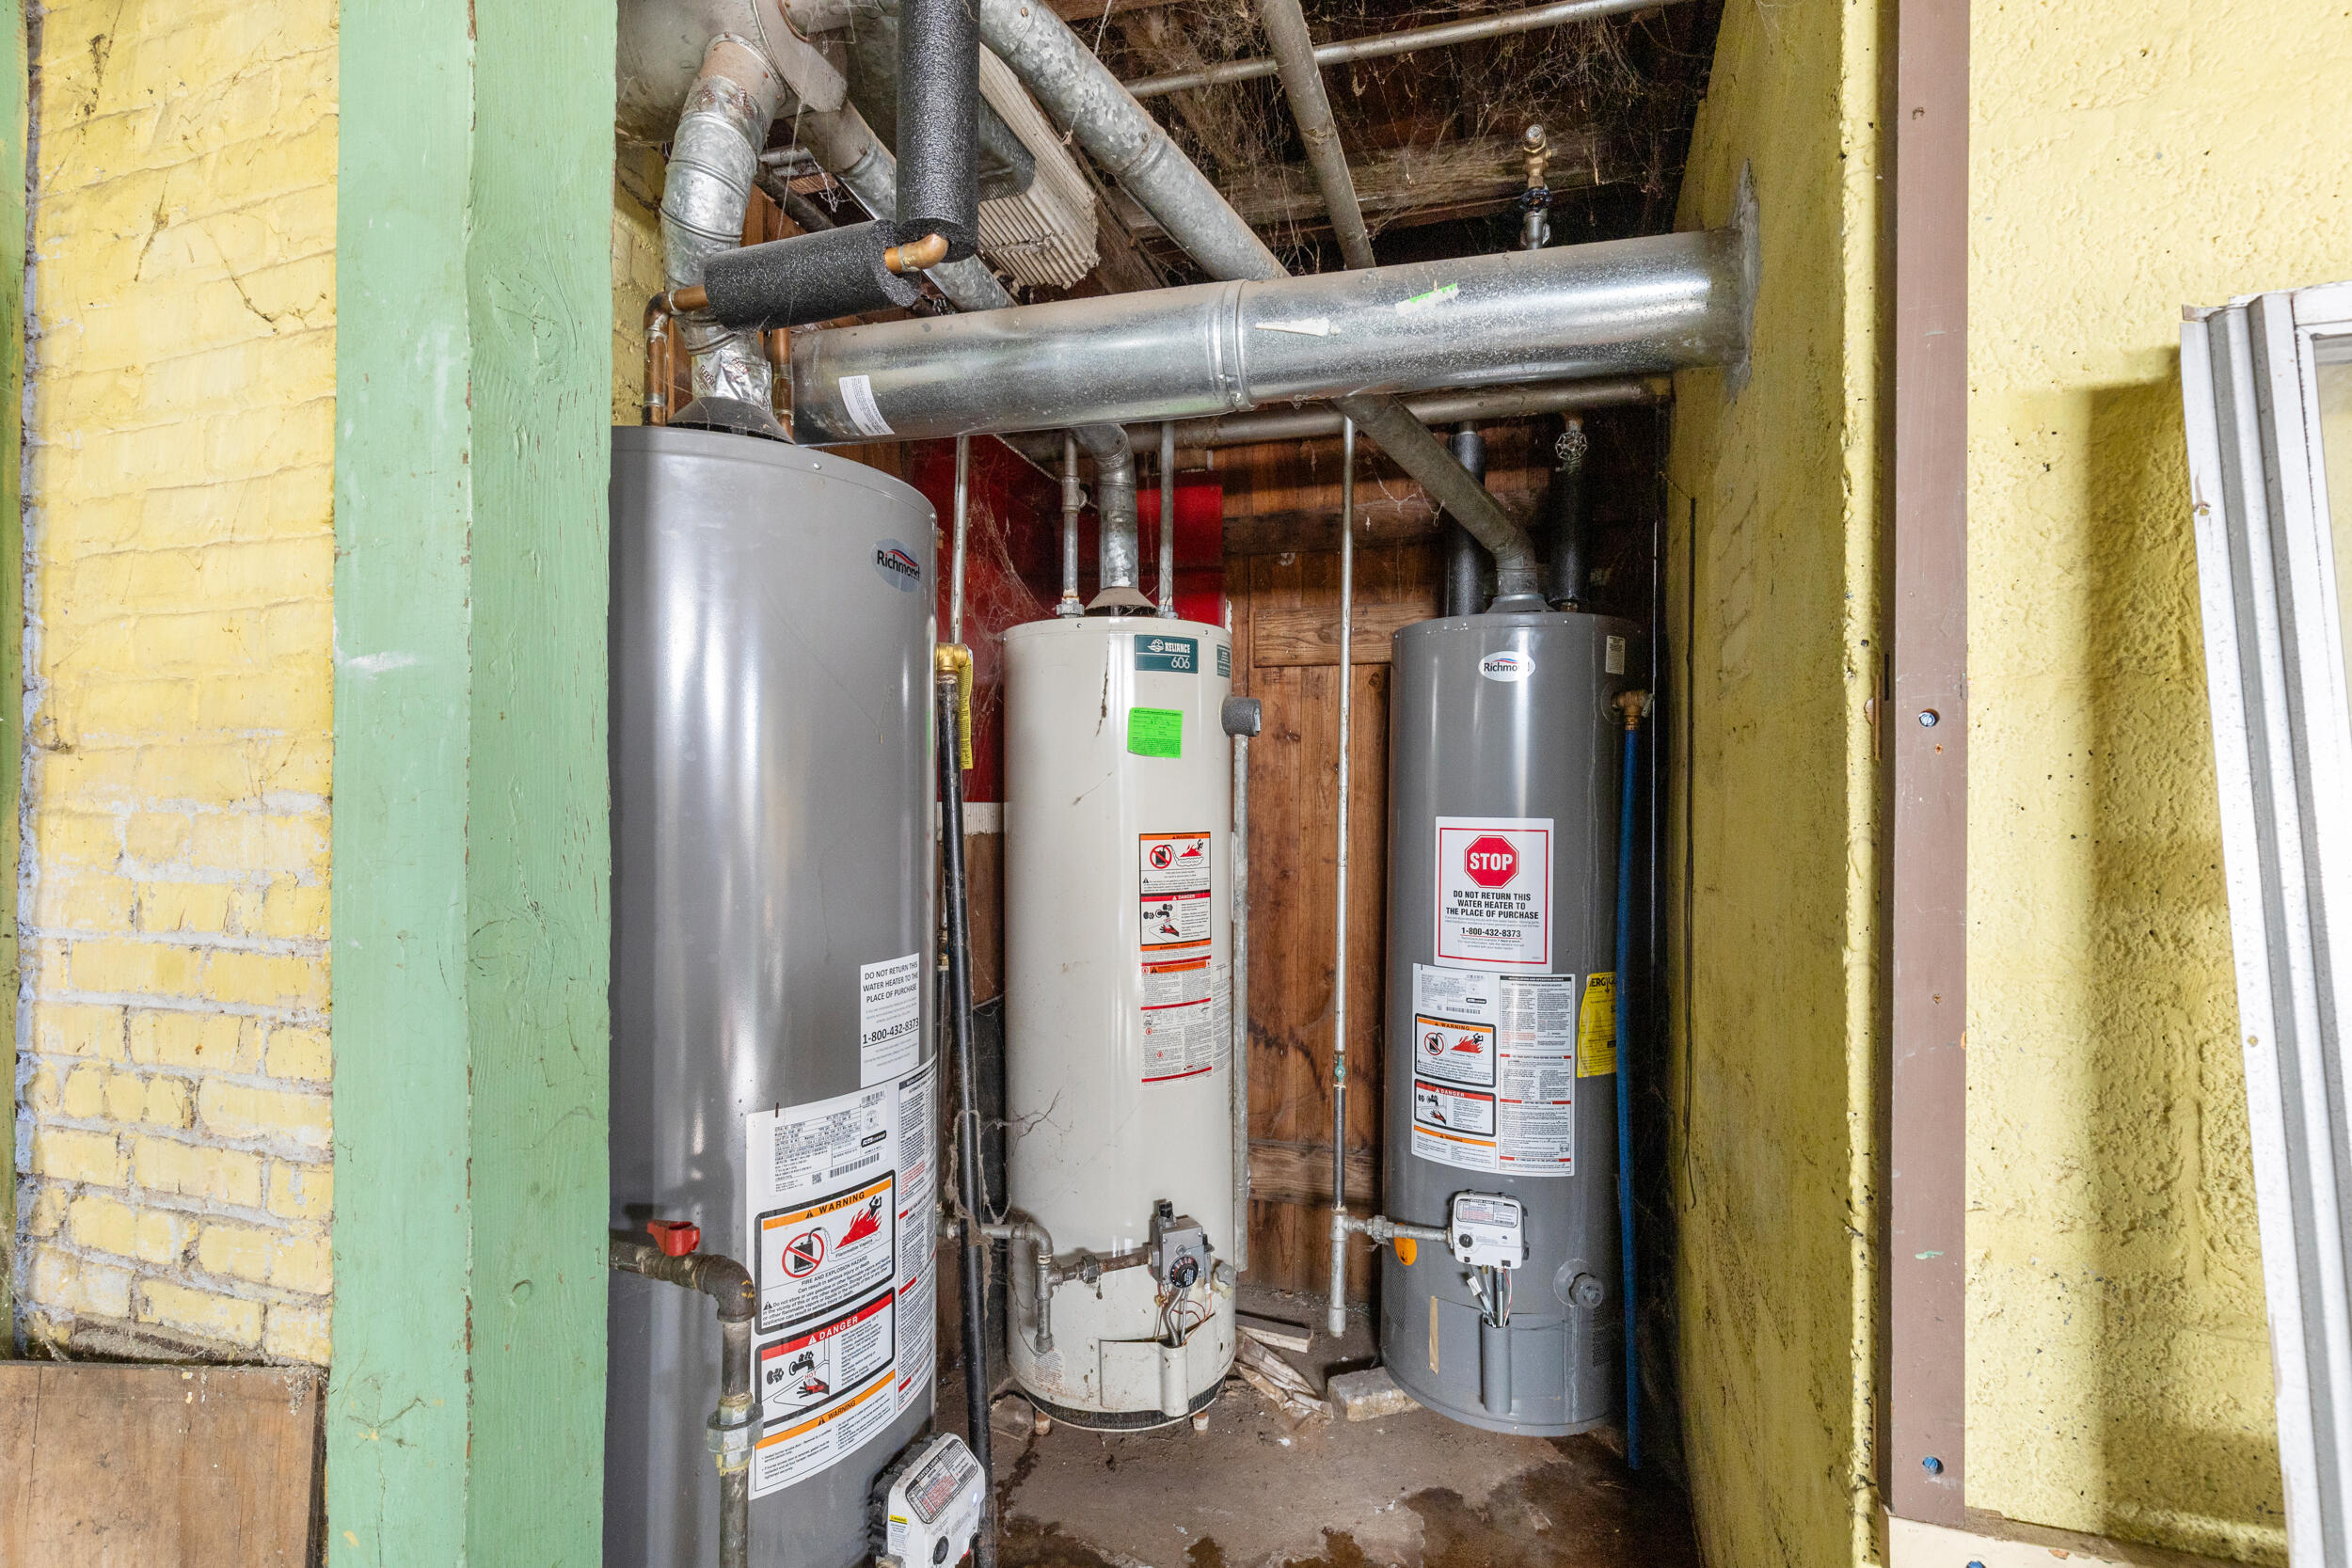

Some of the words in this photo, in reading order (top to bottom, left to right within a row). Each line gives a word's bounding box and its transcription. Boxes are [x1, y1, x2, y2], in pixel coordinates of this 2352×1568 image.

[877, 549, 920, 581] Richmond
[1165, 642, 1190, 653] RELIANCE
[1170, 657, 1190, 669] 606
[1484, 662, 1530, 672] Richmo
[1470, 852, 1513, 871] STOP
[1457, 899, 1483, 908] WATER
[1485, 901, 1513, 910] HEATER
[1481, 892, 1511, 900] RETURN
[1446, 907, 1458, 915] THE
[1461, 909, 1484, 917] PLACE
[1499, 911, 1539, 919] PURCHASE
[1461, 927, 1520, 937] 1-800-432-8373
[865, 972, 875, 980] DO
[876, 970, 888, 978] NOT
[889, 964, 909, 974] RETURN
[910, 961, 918, 970] THIS
[863, 982, 884, 991] WATER
[885, 976, 904, 988] HEATER
[905, 974, 911, 982] TO
[866, 993, 884, 1003] PLACE
[886, 990, 894, 999] OF
[894, 983, 917, 996] PURCHASE
[863, 1018, 918, 1044] 1-800-432-8373
[1441, 1088, 1465, 1097] DANGER
[818, 1192, 865, 1213] WARNING
[819, 1317, 858, 1340] DANGER
[828, 1400, 856, 1418] WARNING
